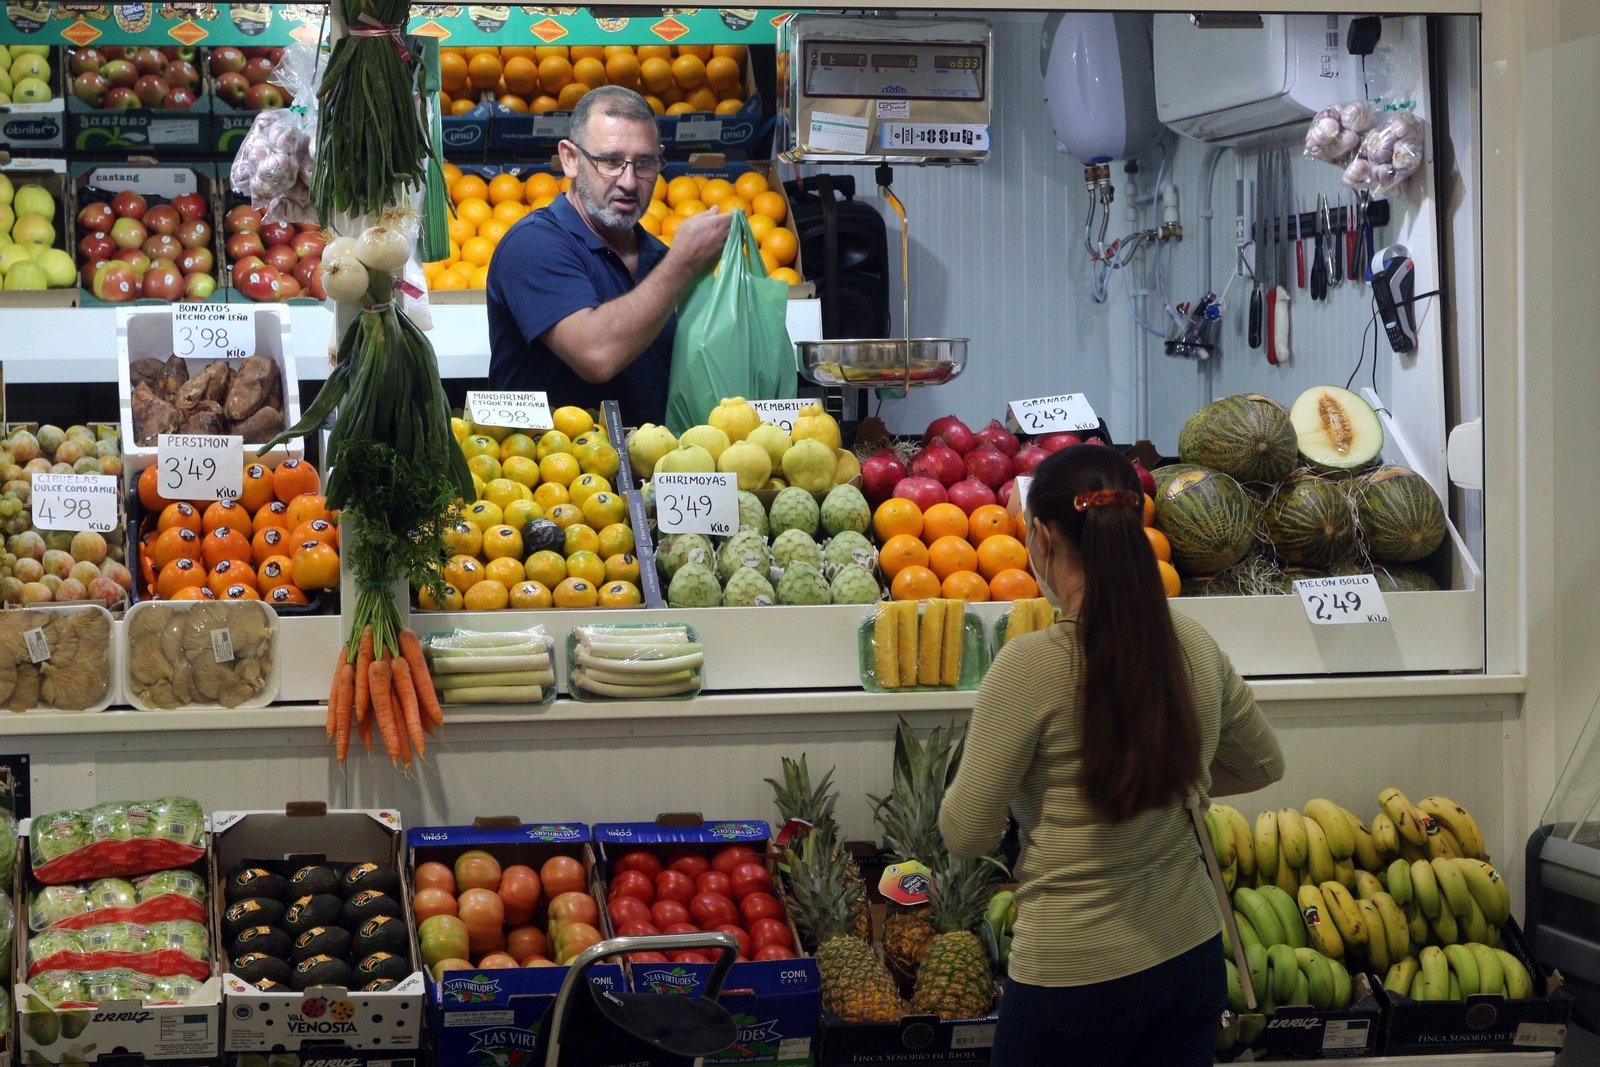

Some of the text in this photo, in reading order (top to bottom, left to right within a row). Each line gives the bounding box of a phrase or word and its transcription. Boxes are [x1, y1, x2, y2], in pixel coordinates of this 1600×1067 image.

[96, 173, 140, 183] castang
[179, 304, 230, 312] BONIATOS
[228, 312, 248, 321] LEÑA
[179, 325, 229, 355] 3'98
[473, 393, 536, 401] MANDARINAS
[1023, 395, 1073, 407] GRANADA
[478, 408, 529, 424] 2'98
[1024, 408, 1067, 428] 2'49
[167, 436, 229, 448] PERSIMON
[165, 456, 216, 489] 3'49
[37, 475, 99, 484] CIRUELAS
[659, 475, 727, 486] CHIRIMOYAS
[38, 496, 92, 524] 4'98
[663, 494, 712, 526] 3'49
[648, 573, 656, 593] QUALITY
[1299, 577, 1369, 588] MELÓN BOLLO
[1308, 591, 1362, 620] 2'49
[649, 973, 692, 985] LAS VIRTUDES
[780, 970, 808, 978] CONIL
[451, 981, 494, 992] LAS VIRTUDES
[93, 1011, 155, 1023] ERRUZ
[1267, 1017, 1322, 1029] ERRUZ
[287, 1022, 357, 1034] VENOSTA
[484, 1032, 506, 1046] LAS
[1418, 1034, 1447, 1042] FINCA
[853, 1054, 883, 1063] FINCA
[948, 1051, 976, 1060] RIOJA
